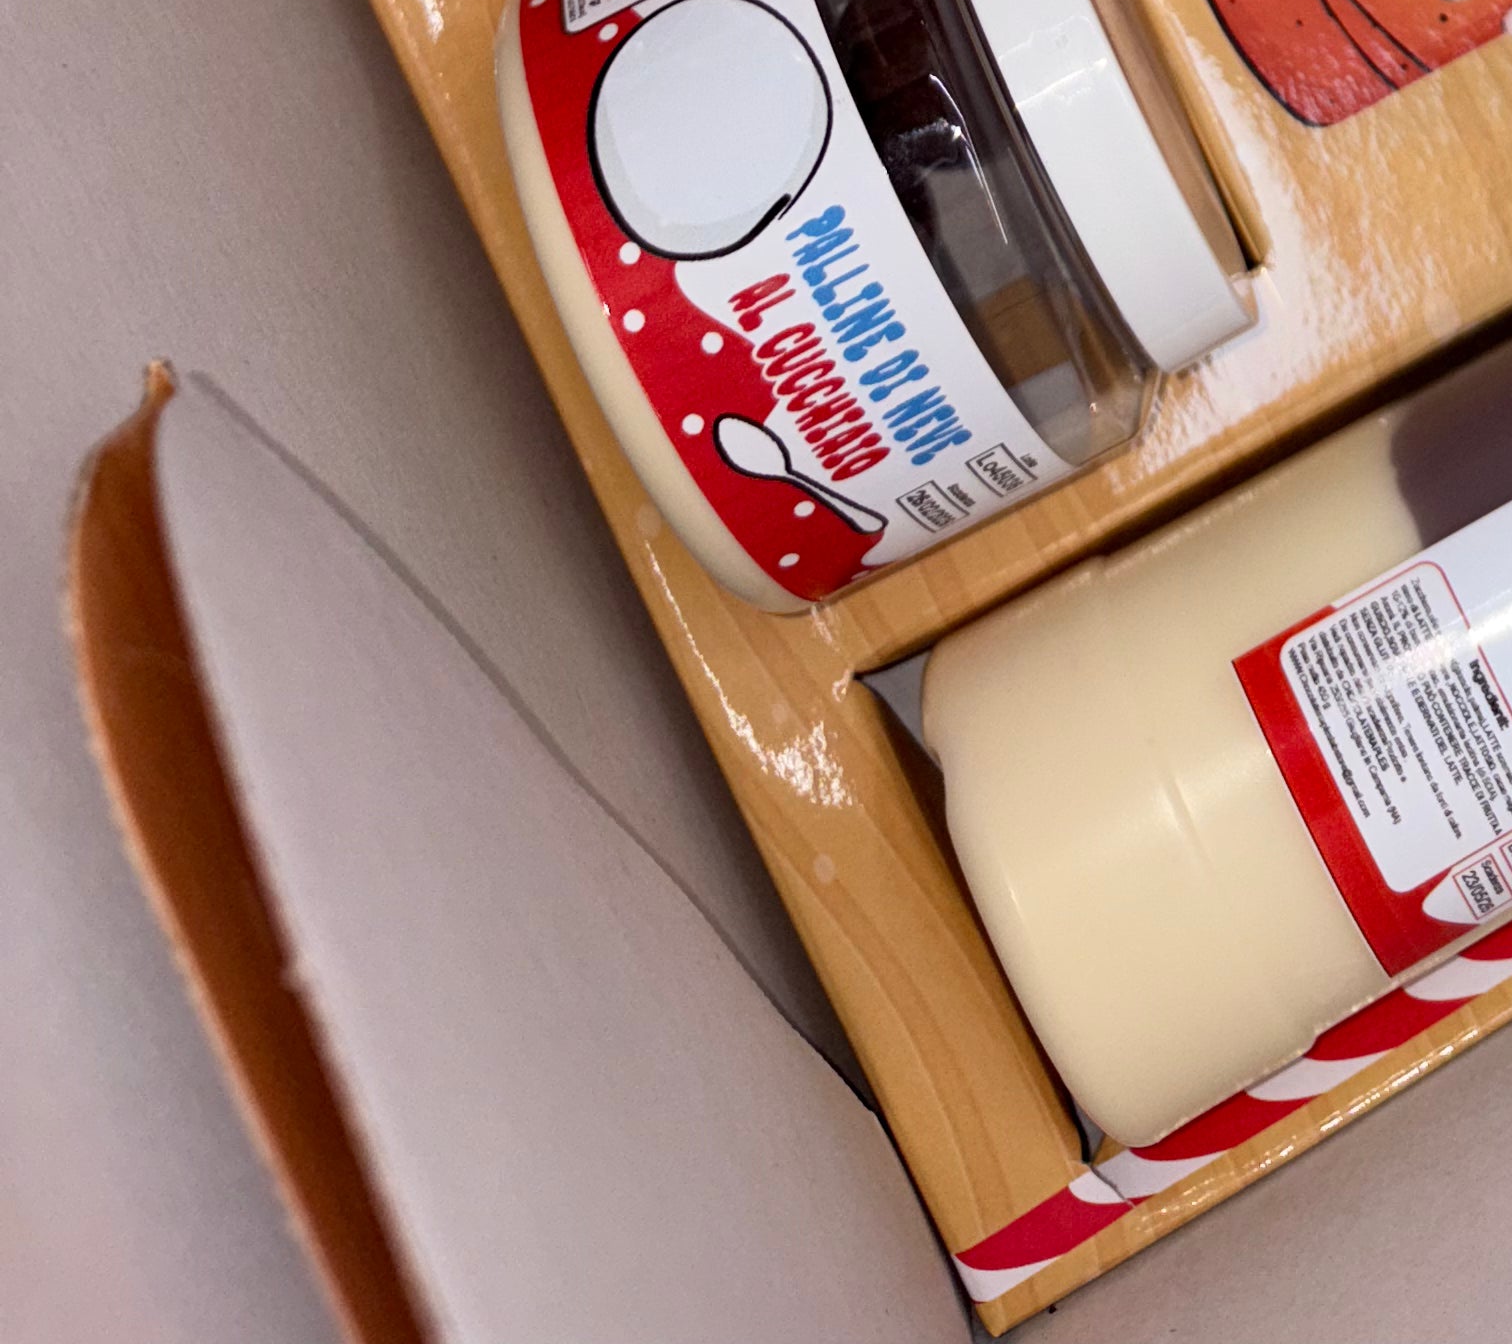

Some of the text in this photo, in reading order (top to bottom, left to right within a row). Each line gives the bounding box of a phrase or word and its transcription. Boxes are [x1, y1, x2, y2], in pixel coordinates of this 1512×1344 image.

[726, 267, 894, 486] AL CUCCHIAIO
[782, 201, 974, 469] PALLINE DI NEVE
[1465, 658, 1511, 732] Ingredienti:
